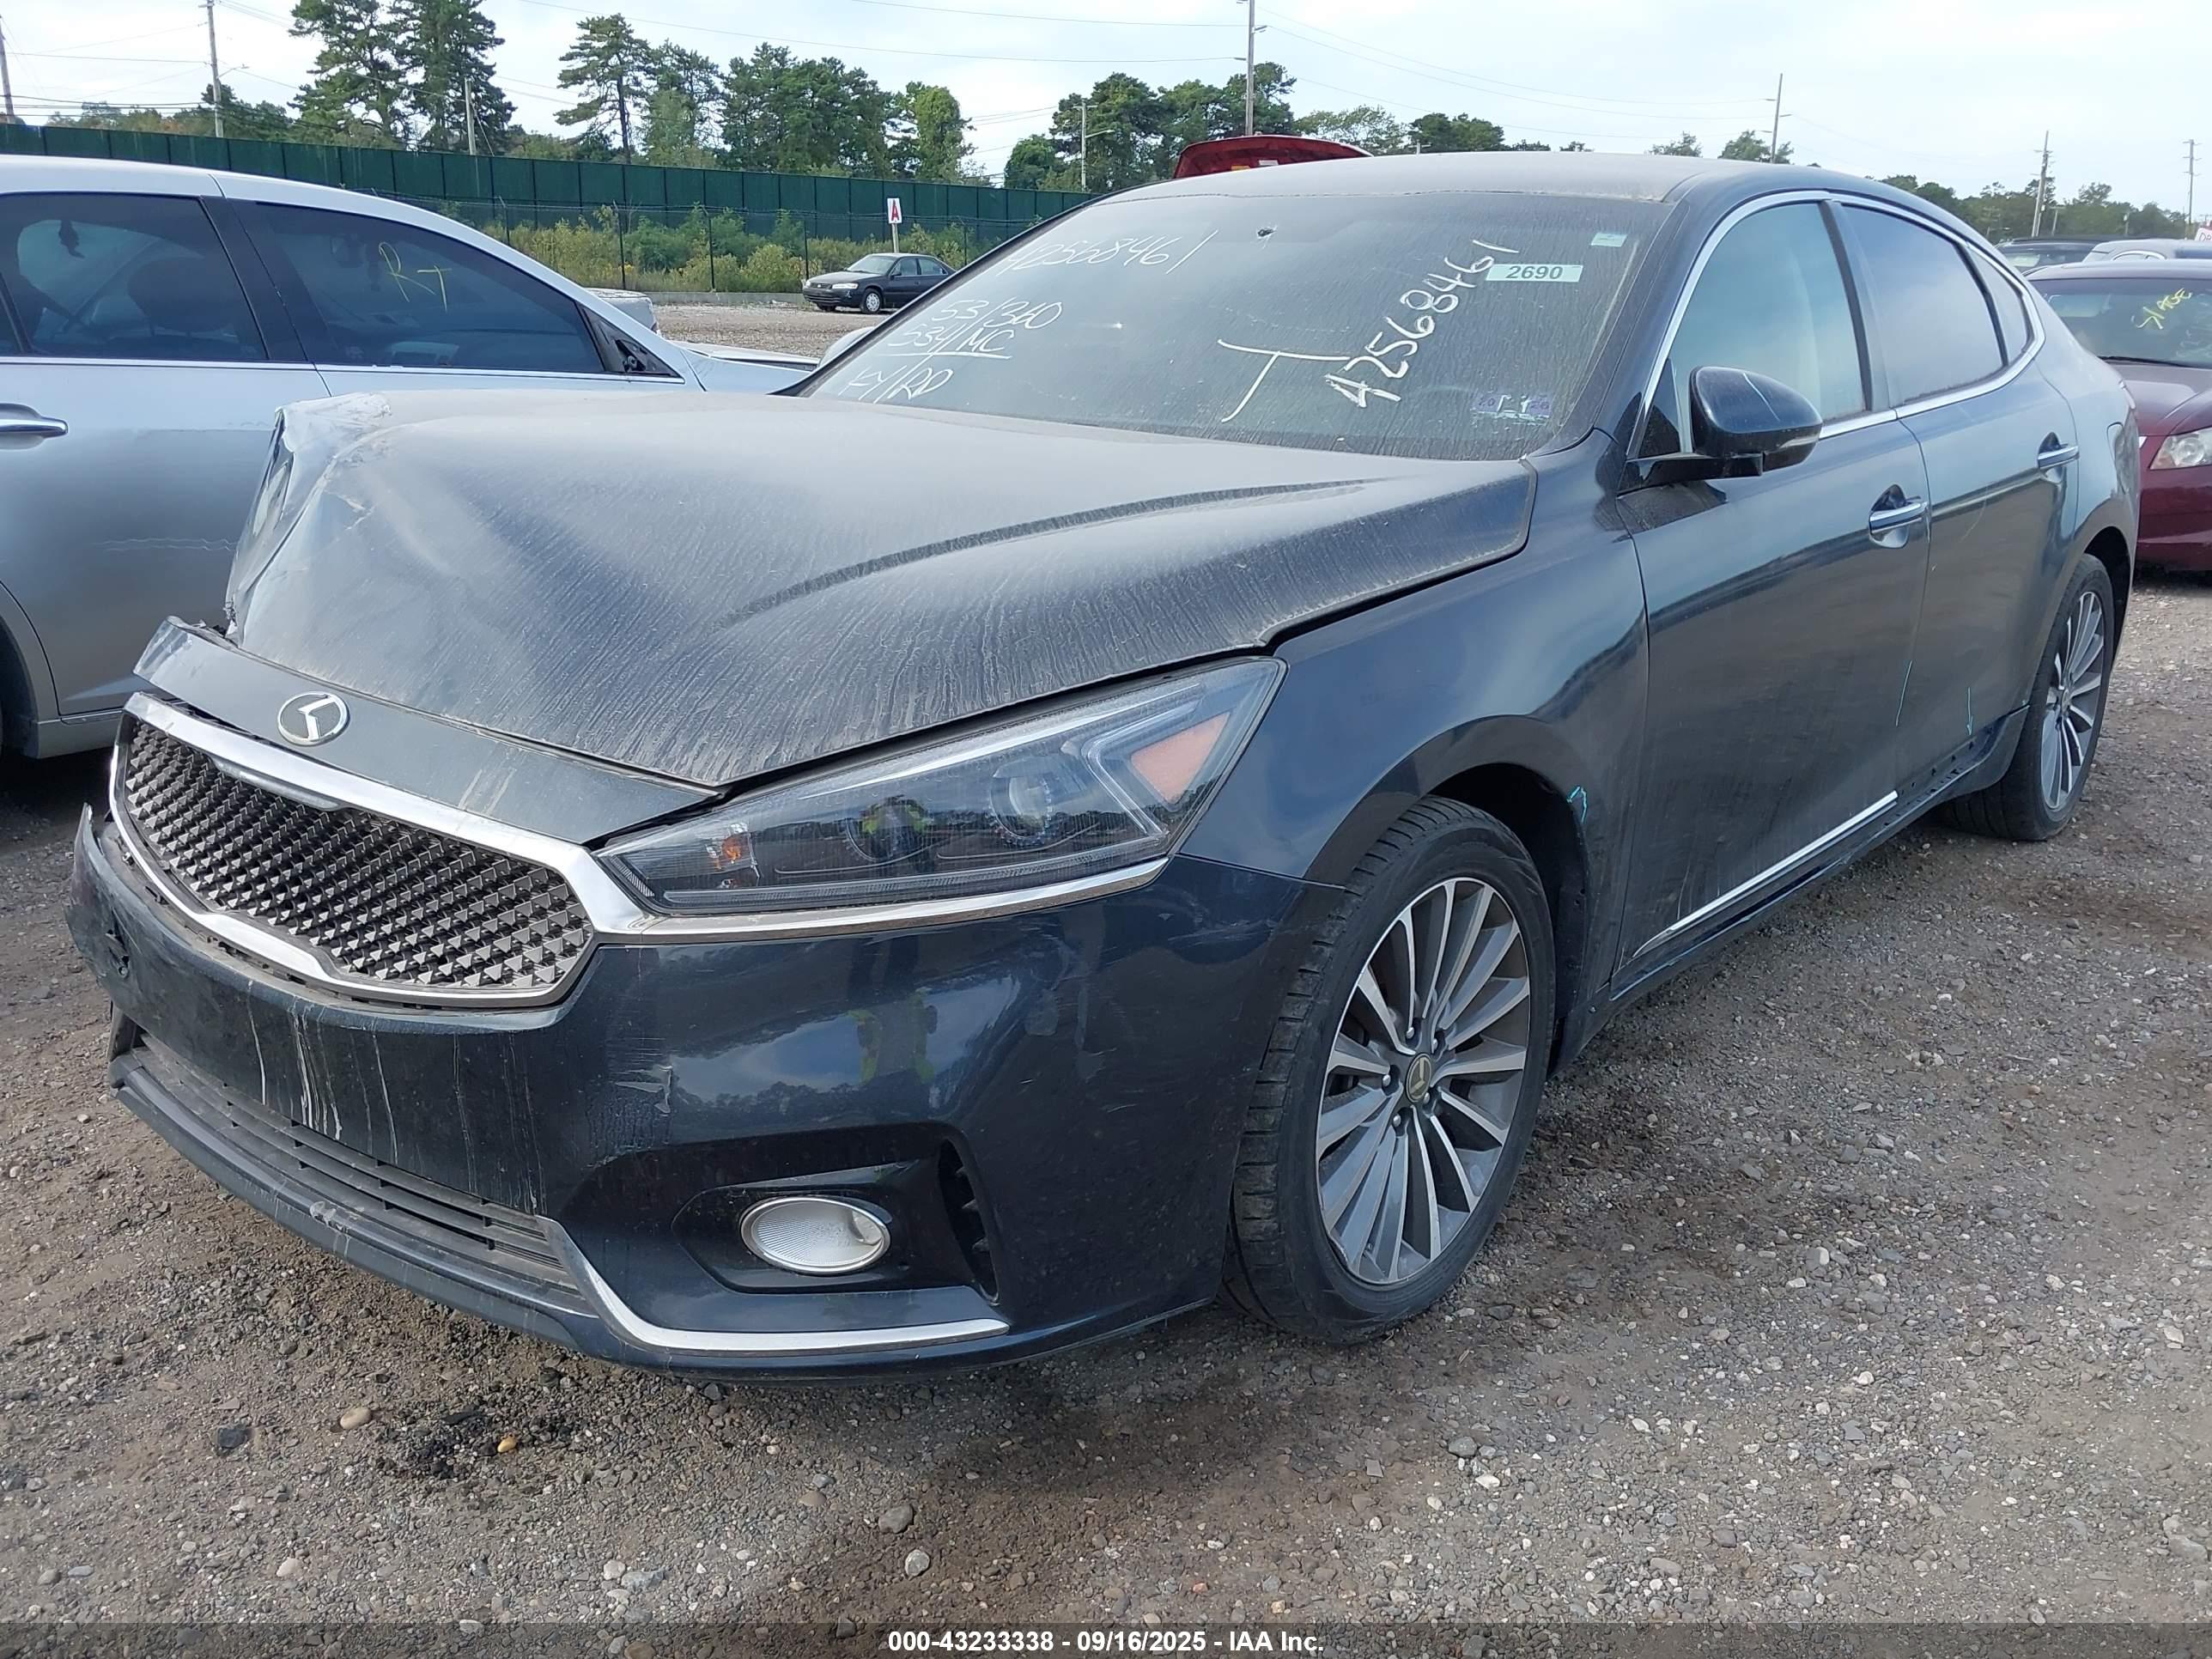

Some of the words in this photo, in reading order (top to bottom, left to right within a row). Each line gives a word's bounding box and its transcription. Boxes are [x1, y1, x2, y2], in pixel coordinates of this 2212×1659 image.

[890, 199, 900, 222] A
[1504, 265, 1564, 281] 2690
[1324, 238, 1520, 409] 42568461
